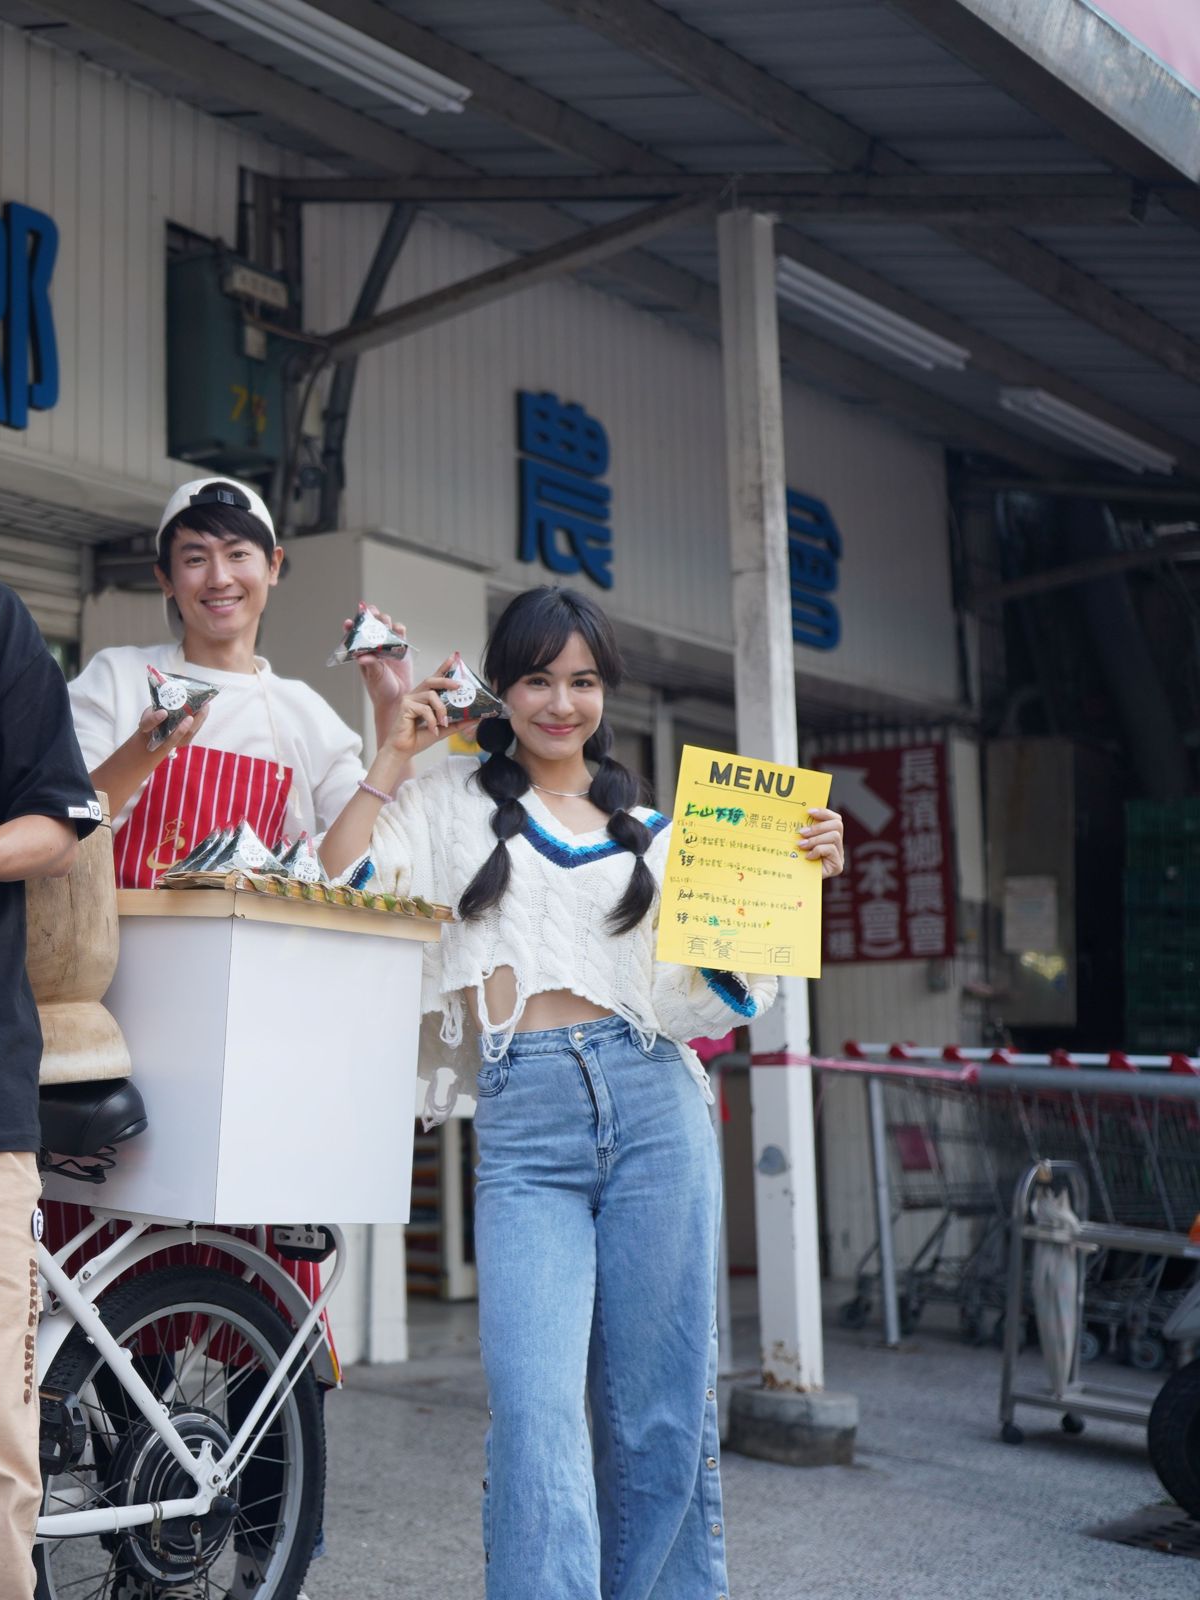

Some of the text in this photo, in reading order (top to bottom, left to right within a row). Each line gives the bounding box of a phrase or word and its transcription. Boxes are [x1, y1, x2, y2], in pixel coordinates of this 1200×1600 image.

[708, 760, 796, 798] MENU
[687, 935, 793, 964] 套餐一佰
